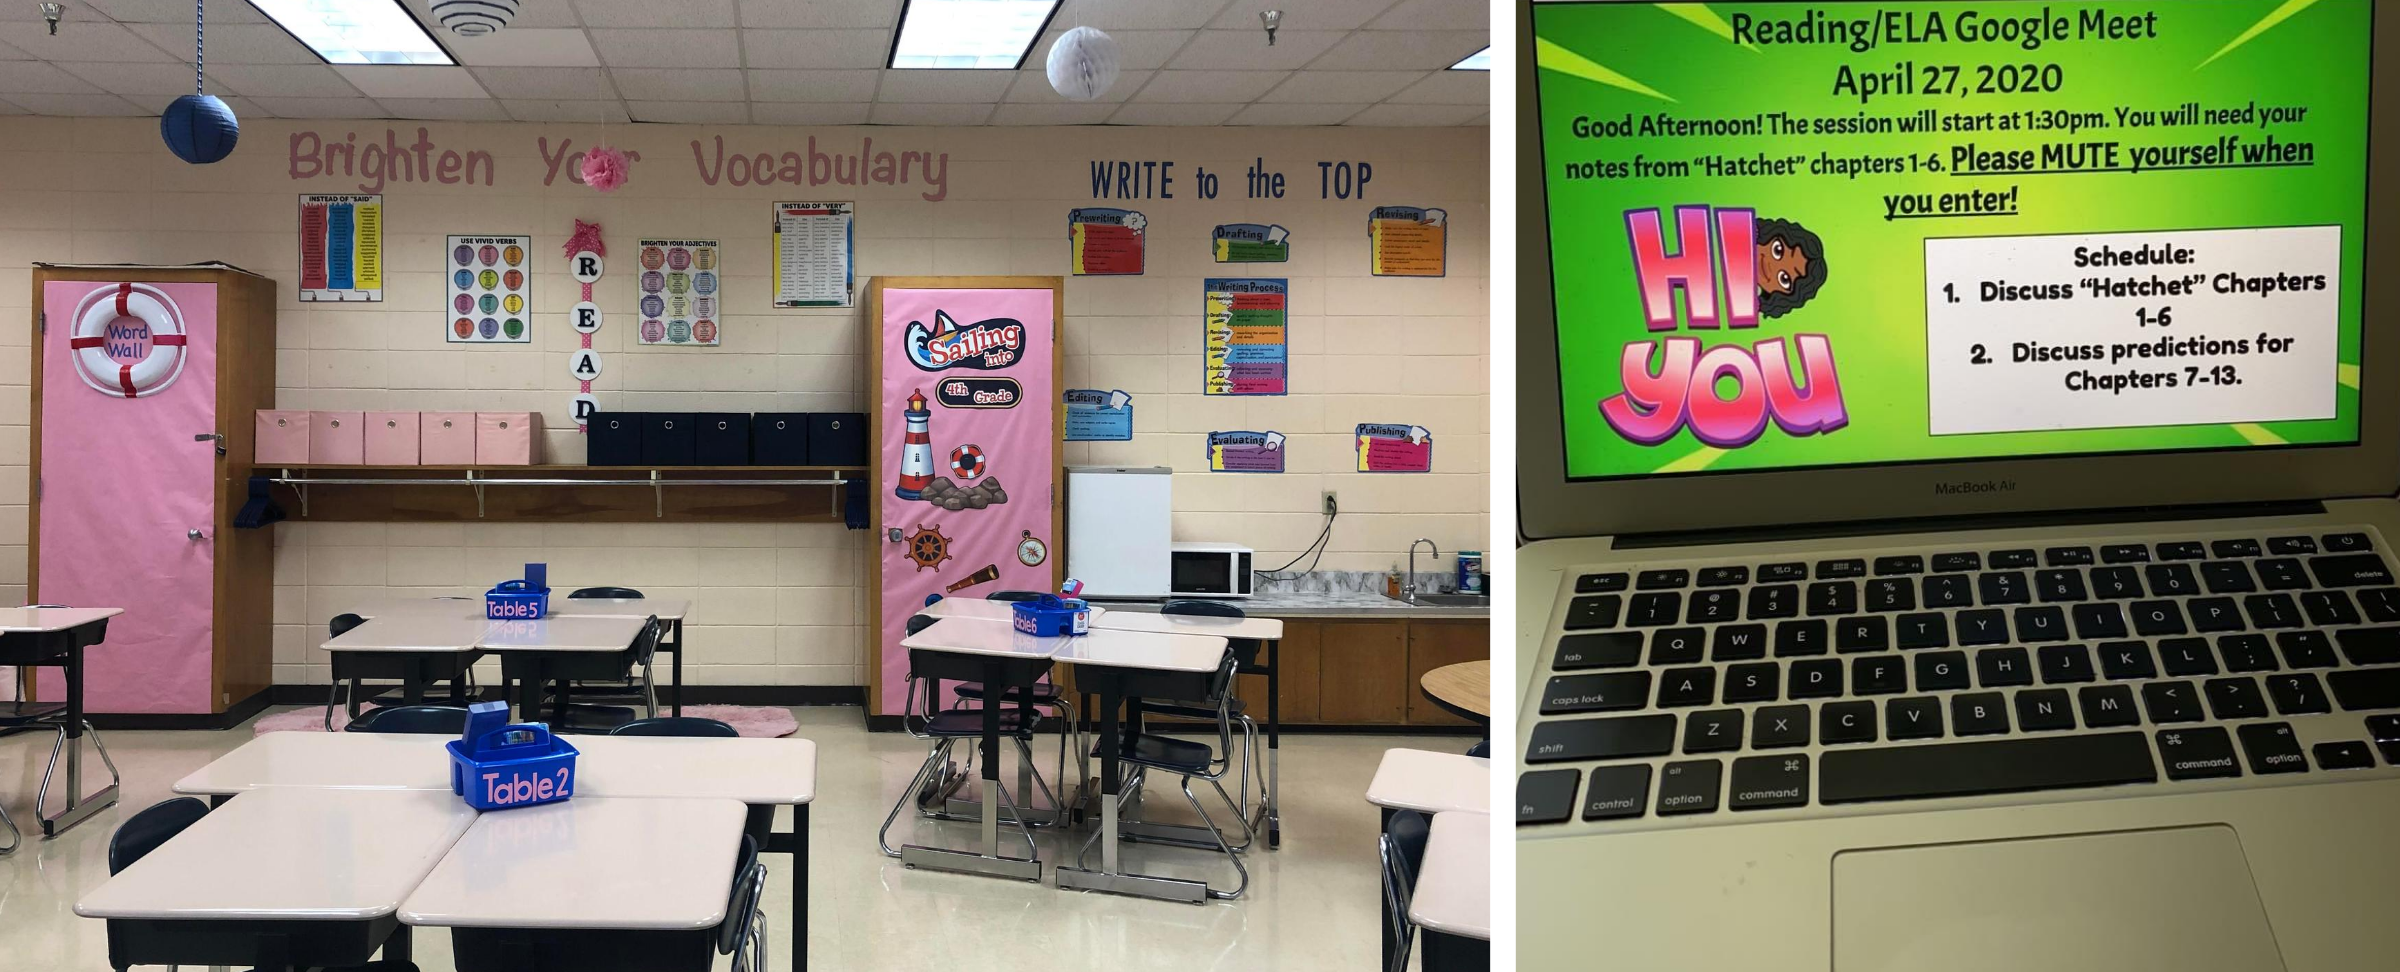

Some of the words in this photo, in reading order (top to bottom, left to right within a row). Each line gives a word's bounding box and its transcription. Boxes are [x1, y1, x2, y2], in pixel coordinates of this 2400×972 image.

[1732, 10, 1946, 52] Reading/ELA
[1955, 8, 2069, 50] Google
[2079, 9, 2157, 39] Meet
[1833, 62, 1912, 103] April
[1922, 65, 1968, 98] 27,
[1976, 63, 2063, 94] 2020
[1572, 114, 1633, 138] Good
[1638, 115, 1762, 137] Afternoon!
[1767, 112, 1808, 135] The
[1813, 112, 1892, 134] session
[1897, 110, 1936, 133] will
[1942, 110, 1994, 132] start
[1999, 111, 2020, 130] at
[2026, 110, 2109, 134] 1:30pm.
[2114, 106, 2154, 128] You
[2160, 103, 2198, 126] will
[2204, 102, 2254, 125] need
[2259, 107, 2307, 128] your
[1565, 158, 1628, 179] notes
[1634, 155, 1689, 177] from
[1694, 153, 1805, 176] “Hatchet”
[1810, 152, 1904, 179] chapters
[1909, 155, 1946, 172] 1-6.
[1951, 143, 2034, 172] Please
[2042, 142, 2119, 169] MUTE
[2129, 136, 2238, 174] yourself
[2242, 136, 2313, 163] when
[289, 127, 494, 194] Brighten
[538, 137, 641, 187] Yor
[690, 135, 949, 201] Vocabulary
[1091, 161, 1174, 199] WRITE
[1196, 166, 1218, 199] to
[1247, 157, 1285, 199] the
[1318, 161, 1372, 199] TOP
[1884, 193, 1932, 220] you
[1939, 186, 2017, 213] enter!
[1073, 210, 1121, 224] Prewriting
[1376, 208, 1418, 221] Revising
[1217, 227, 1263, 241] Drafting
[2075, 244, 2195, 268] Schedule:
[1623, 204, 1759, 332] HI
[1219, 282, 1248, 292] Writing
[1250, 282, 1283, 292] Process
[1943, 283, 1960, 303] 1.
[1981, 281, 2073, 302] Discuss
[2081, 274, 2205, 298] “Hatchet”
[2213, 272, 2326, 297] Chapters
[2136, 307, 2171, 326] 1-6
[108, 324, 148, 340] Word
[108, 343, 142, 358] Wall
[928, 324, 1021, 366] Sailing
[1971, 344, 1992, 364] 2.
[2012, 341, 2104, 363] Discuss
[2112, 335, 2249, 365] predictions
[2256, 333, 2293, 354] for
[984, 349, 1014, 367] into
[2065, 370, 2177, 394] Chapters
[2185, 365, 2242, 387] 7-13.
[945, 382, 969, 396] 4th
[974, 390, 1013, 404] Grade
[1068, 391, 1103, 404] Editing
[1360, 424, 1406, 437] Publishing
[1211, 434, 1265, 446] Evaluating
[1936, 480, 1996, 495] MacBook
[2000, 480, 2016, 491] Air
[2354, 570, 2383, 579] delete
[1999, 577, 2008, 585] &
[2114, 582, 2122, 591] 9
[1884, 583, 1895, 591] %
[2001, 588, 2009, 596] 7
[2058, 585, 2066, 594] 8
[1770, 590, 1778, 598] #
[1886, 595, 1894, 604] 5
[1944, 591, 1953, 600] 6
[1769, 602, 1777, 610] 3
[1828, 598, 1836, 607] 4
[1708, 607, 1717, 615] 2
[2211, 608, 2220, 618] P
[1977, 620, 1987, 630] Y
[2035, 617, 2047, 627] U
[1858, 628, 1868, 638] R
[1917, 624, 1926, 633] T
[1732, 635, 1748, 644] W
[1797, 631, 1805, 641] E
[1671, 639, 1684, 649] Q
[2121, 653, 2134, 664] K
[2183, 650, 2194, 661] L
[1999, 660, 2011, 671] H
[2062, 657, 2070, 668] J
[1876, 668, 1884, 678] F
[1936, 664, 1949, 675] G
[1747, 676, 1756, 686] S
[1811, 672, 1822, 682] D
[1680, 680, 1692, 691] A
[1553, 696, 1578, 705] caps
[1582, 694, 1604, 703] lock
[2101, 699, 2118, 710] M
[1975, 707, 1985, 718] B
[2039, 703, 2052, 714] N
[1842, 715, 1854, 726] C
[1908, 710, 1920, 722] V
[1708, 723, 1719, 735] Z
[1775, 719, 1787, 731] X
[1539, 743, 1564, 753] shift
[2176, 757, 2232, 769] command
[2266, 754, 2301, 764] option
[1739, 787, 1799, 800] command
[1592, 798, 1633, 810] control
[1665, 794, 1702, 806] option
[1522, 805, 1534, 814] fn
